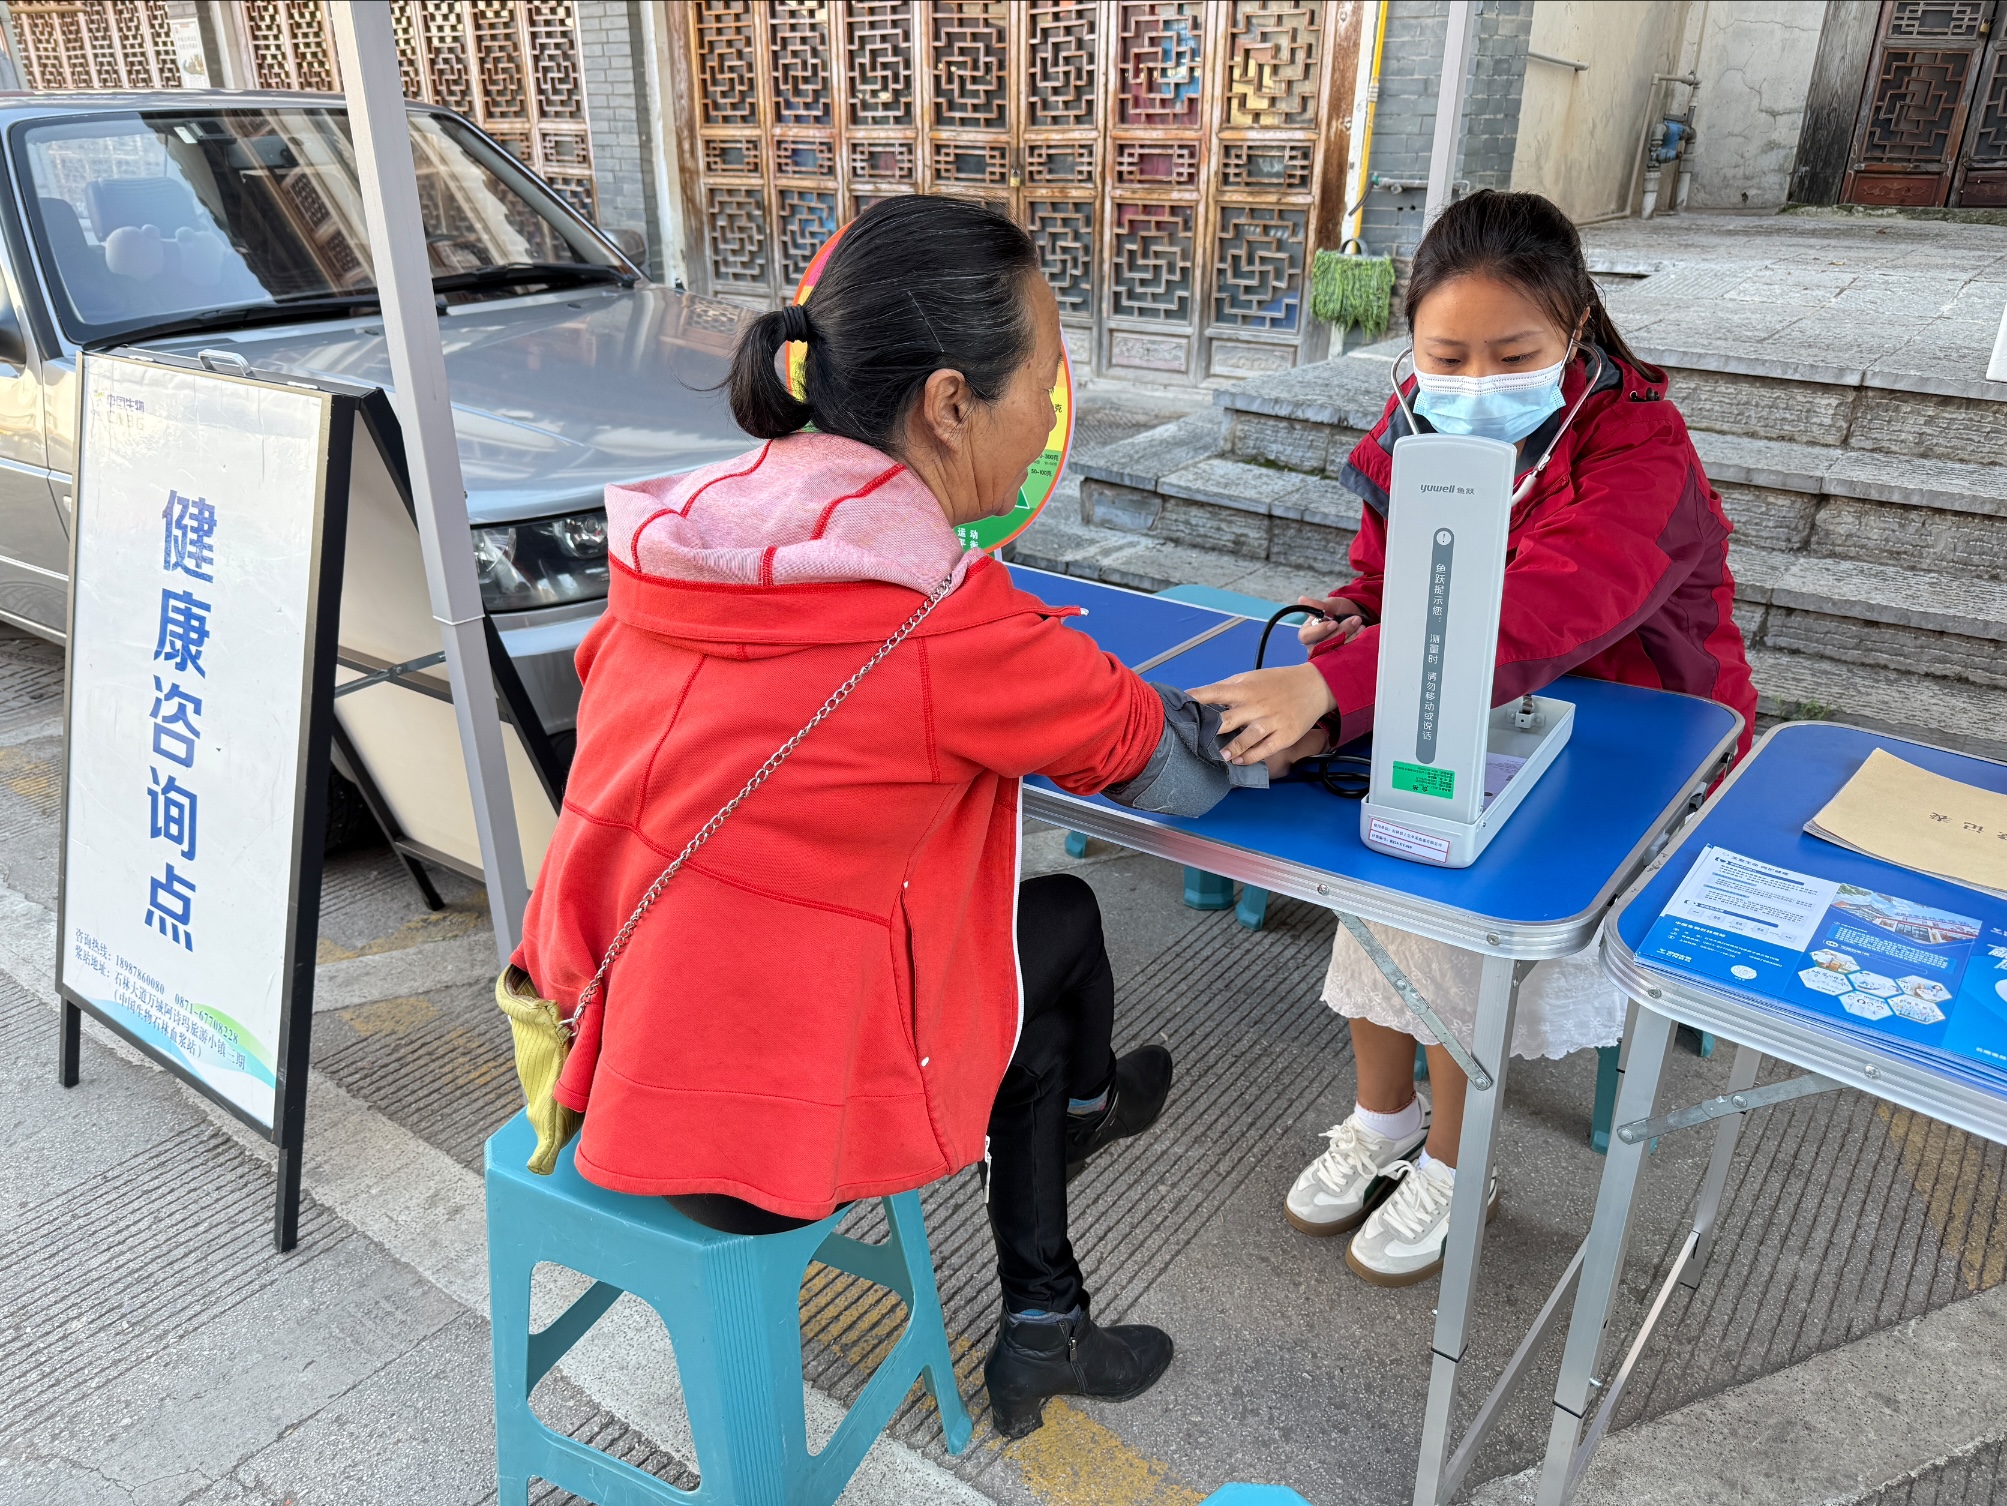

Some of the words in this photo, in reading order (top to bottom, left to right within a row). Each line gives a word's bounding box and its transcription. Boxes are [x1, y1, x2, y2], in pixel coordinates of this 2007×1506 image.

[1420, 484, 1455, 493] yuwell
[1456, 486, 1475, 495] 鱼跃
[144, 490, 217, 953] 健康咨询点
[174, 993, 239, 1044] 0871-67708228
